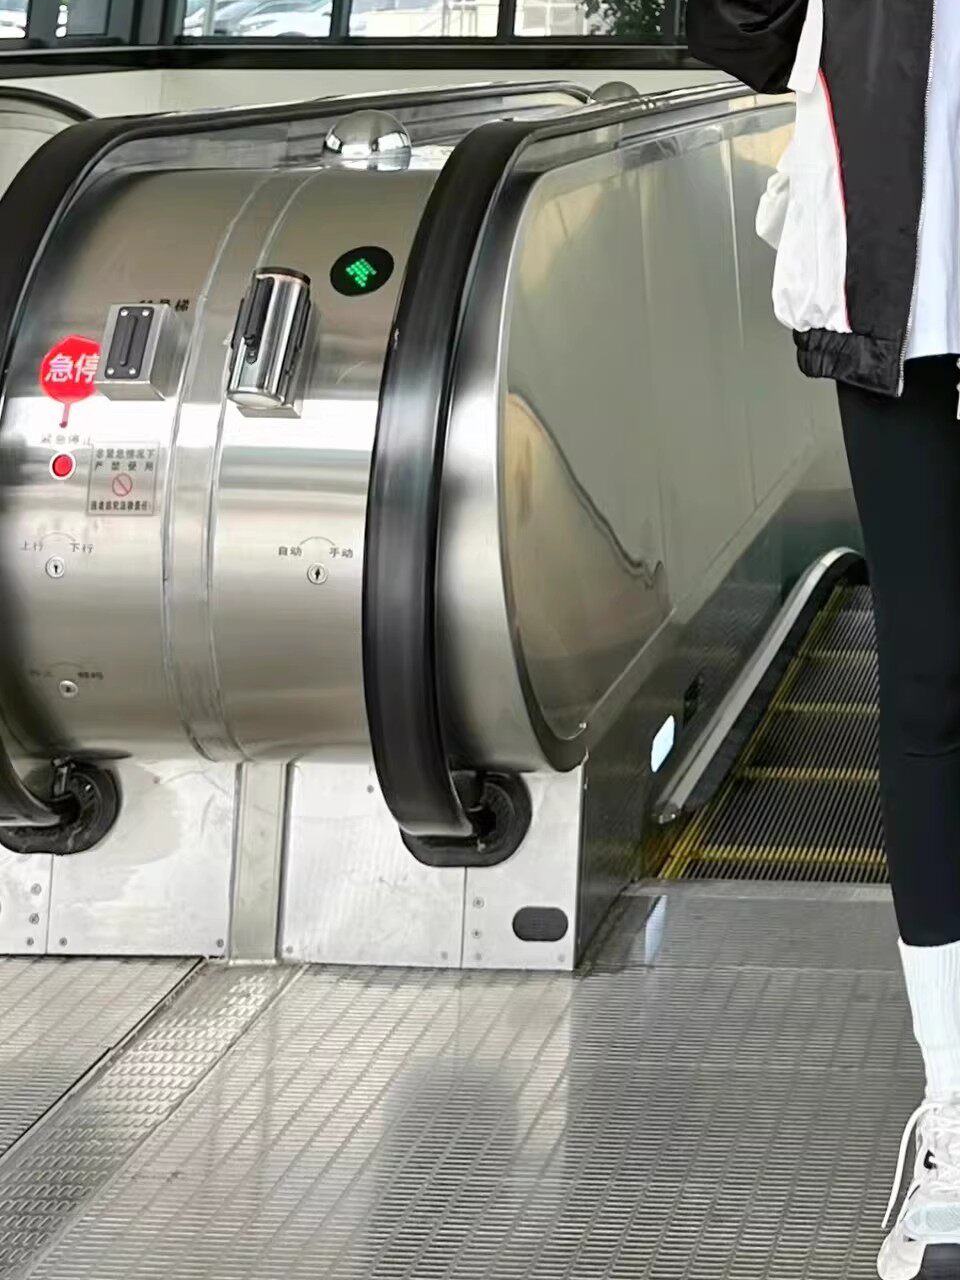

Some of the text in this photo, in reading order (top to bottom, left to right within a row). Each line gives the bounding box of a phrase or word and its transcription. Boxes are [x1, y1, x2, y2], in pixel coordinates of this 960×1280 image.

[45, 353, 100, 382] 急停
[70, 543, 94, 554] 下行
[278, 546, 302, 557] 自动
[329, 547, 353, 558] 手动
